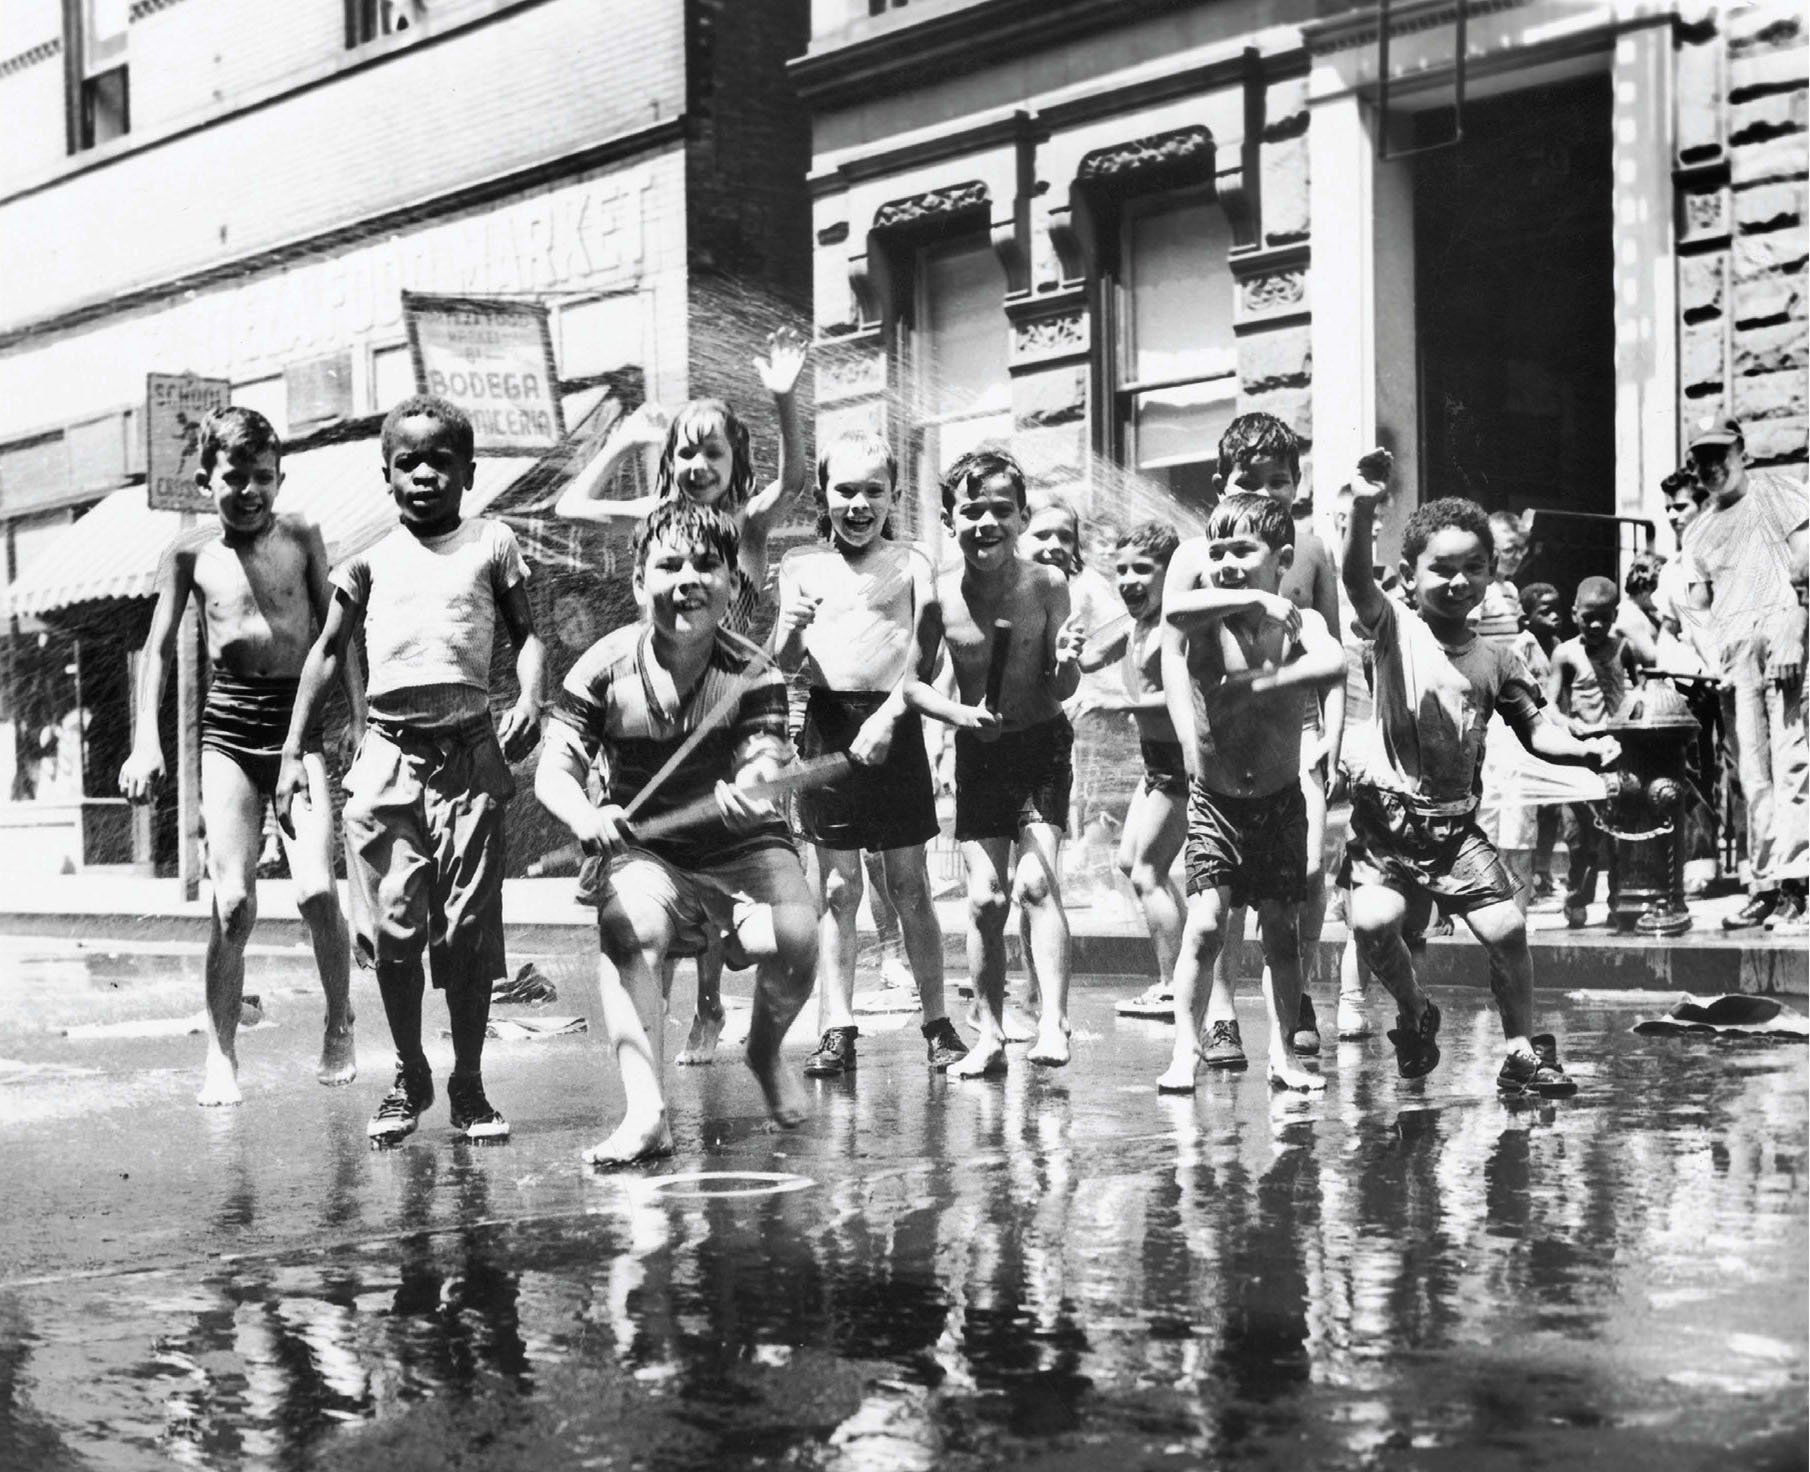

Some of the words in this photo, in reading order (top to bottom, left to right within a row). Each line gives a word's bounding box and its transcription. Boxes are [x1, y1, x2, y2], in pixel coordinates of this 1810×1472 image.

[154, 383, 220, 411] SCHOOL
[429, 369, 540, 400] BODEGA
[473, 409, 552, 437] NICERIA
